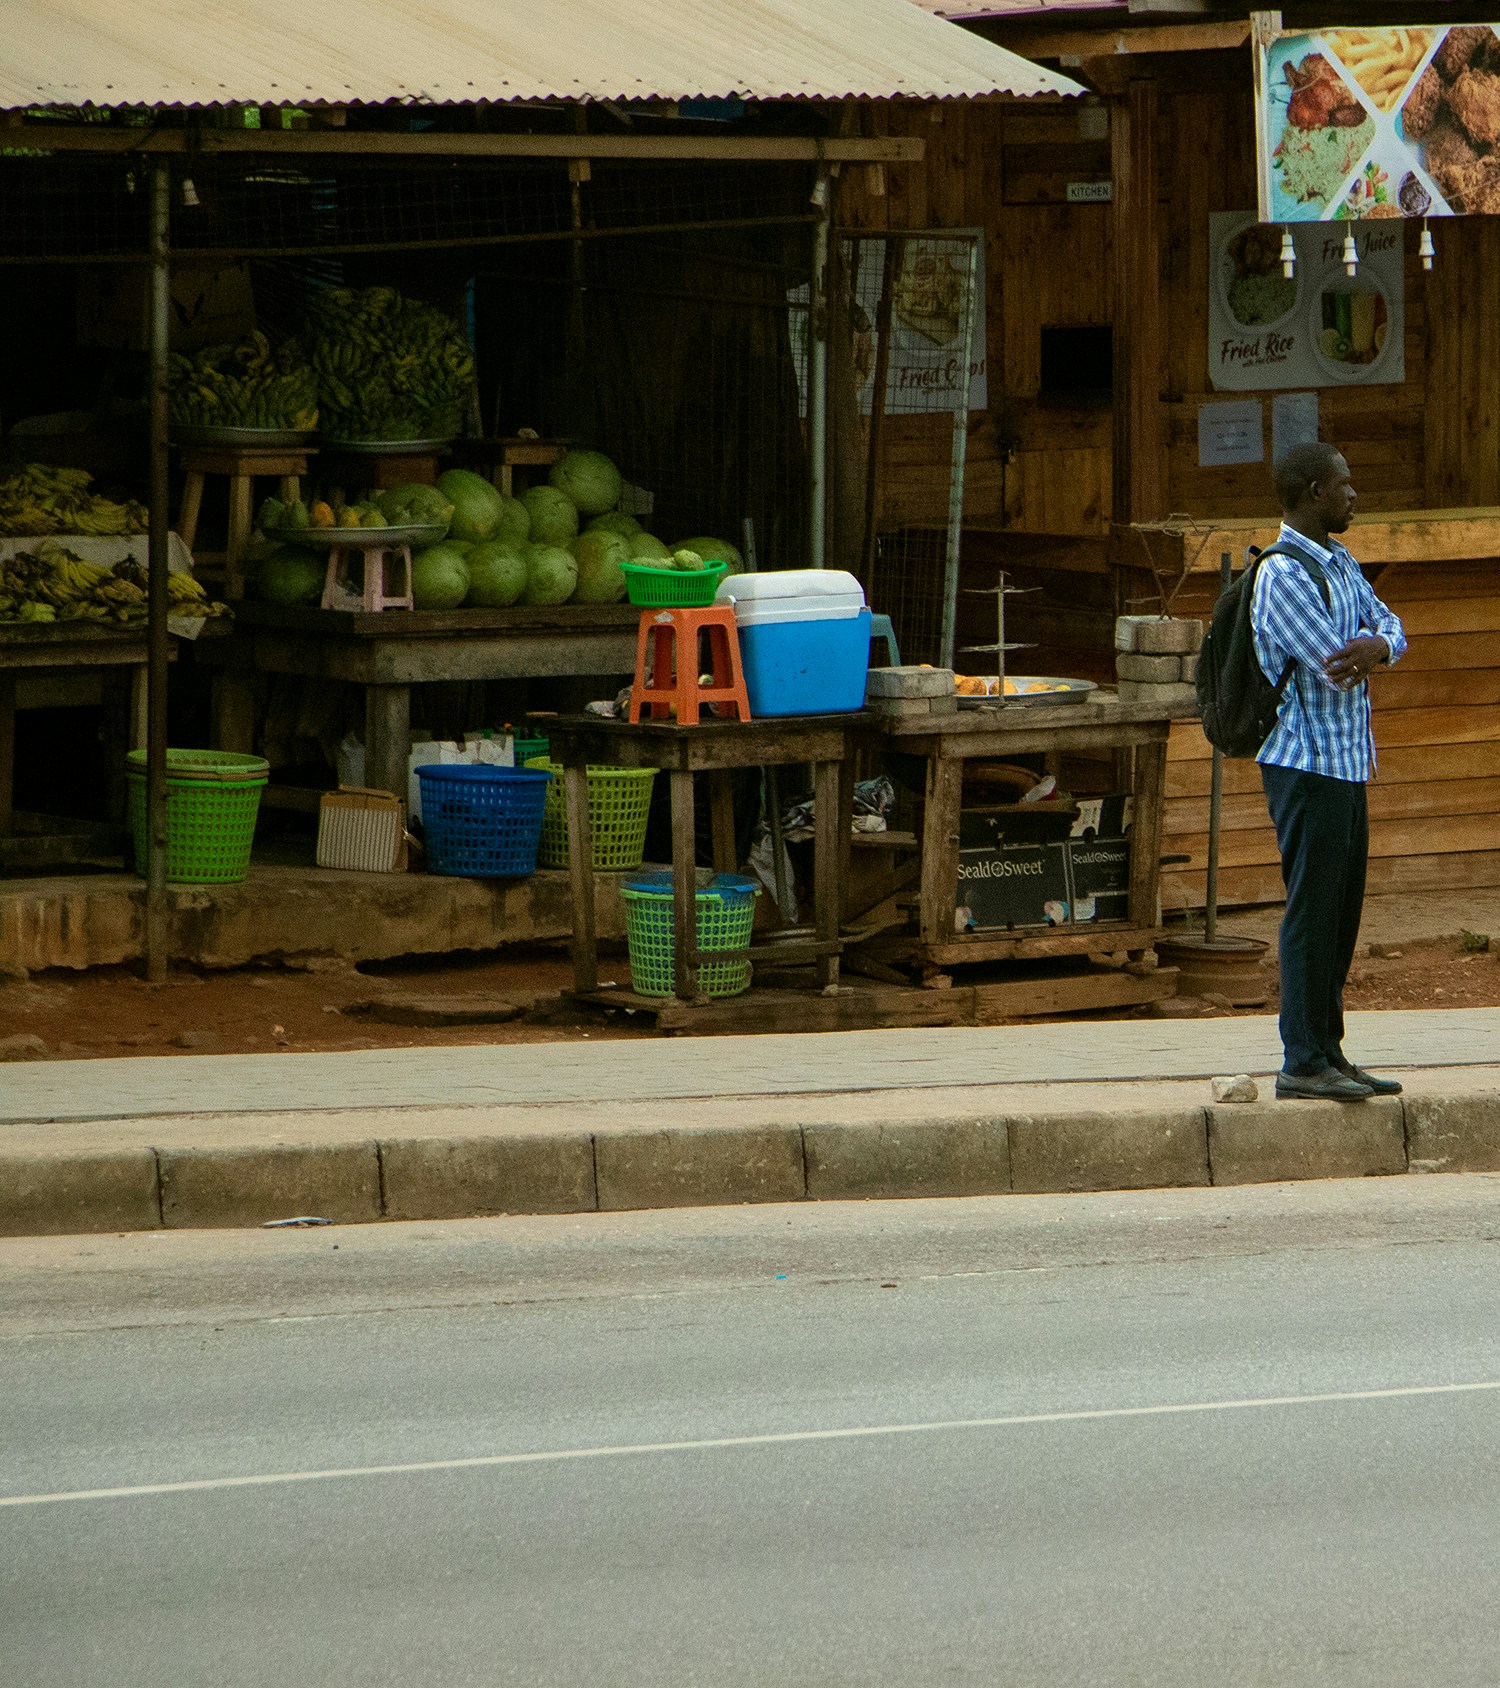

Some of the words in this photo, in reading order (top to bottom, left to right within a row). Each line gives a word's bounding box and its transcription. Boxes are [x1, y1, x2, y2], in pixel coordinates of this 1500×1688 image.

[1071, 186, 1109, 197] KITCHEN
[1363, 232, 1397, 259] Juice
[1220, 336, 1261, 363] Fried
[1265, 333, 1295, 356] Rice
[900, 367, 939, 389] Fried
[1072, 853, 1096, 864] Seald
[957, 861, 992, 880] Seald
[1003, 859, 1043, 877] Sweet
